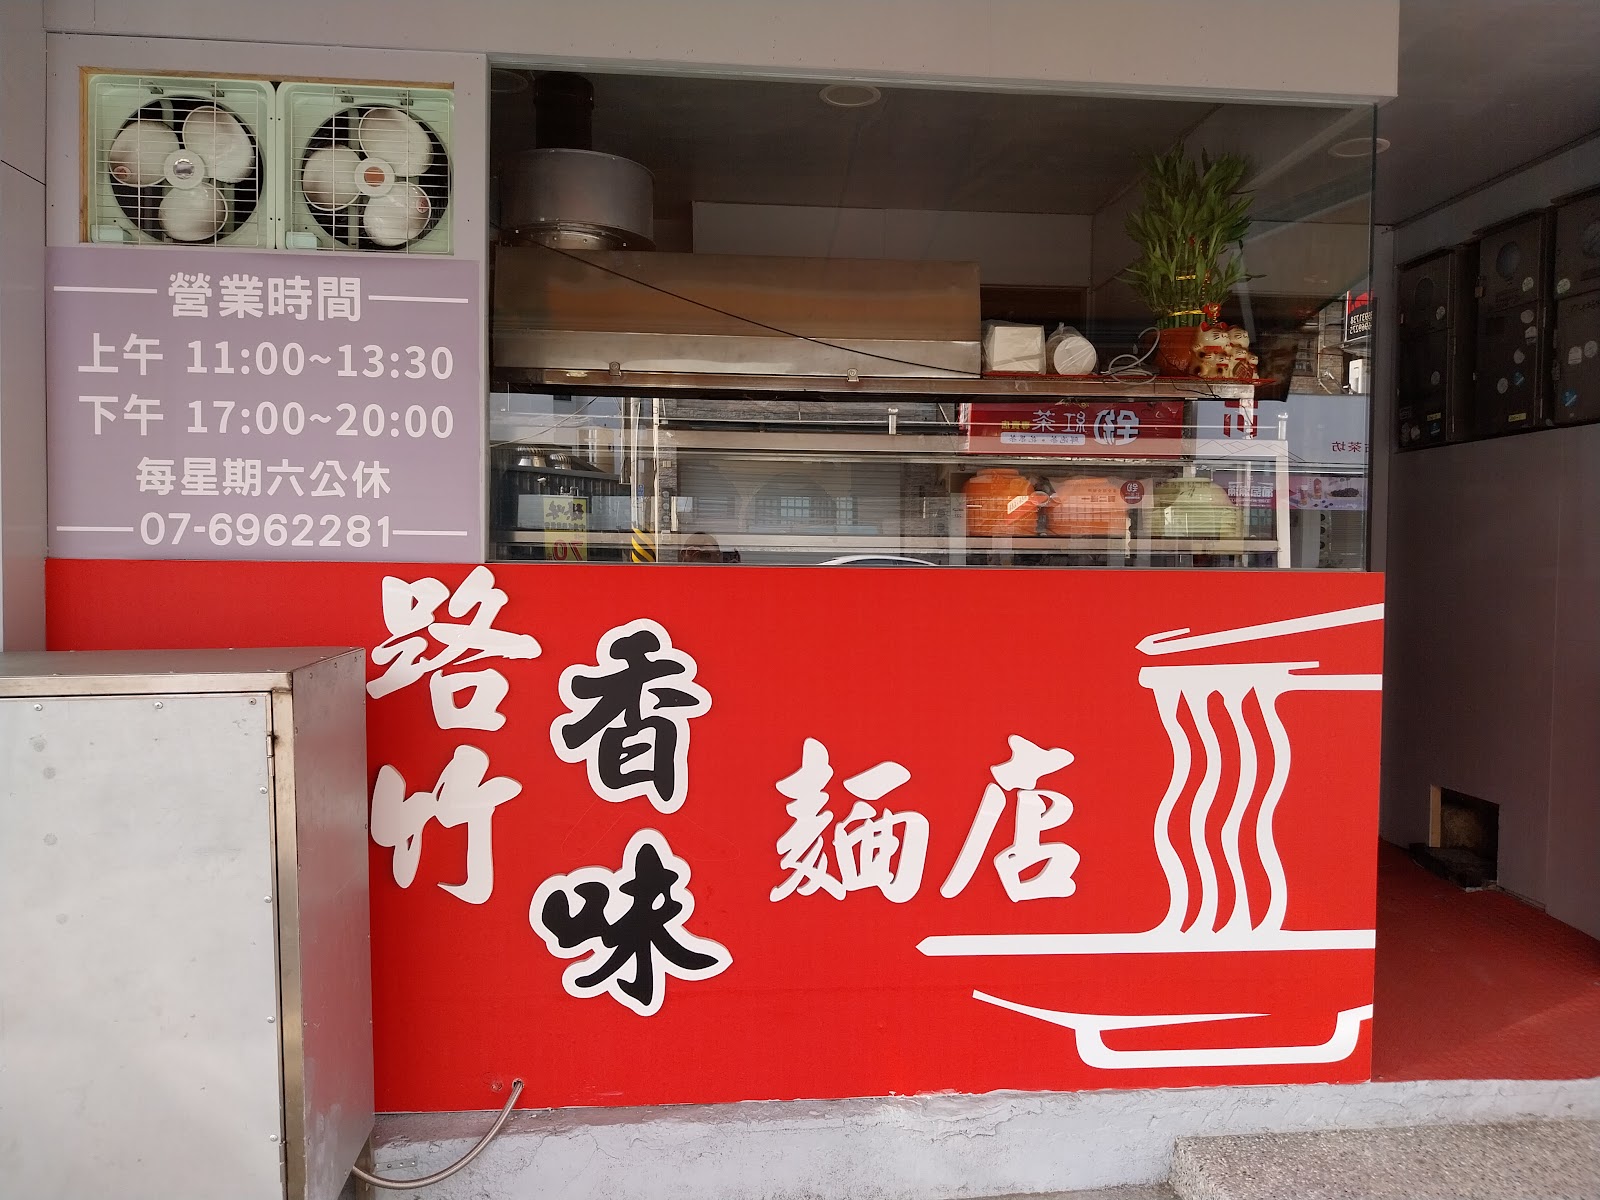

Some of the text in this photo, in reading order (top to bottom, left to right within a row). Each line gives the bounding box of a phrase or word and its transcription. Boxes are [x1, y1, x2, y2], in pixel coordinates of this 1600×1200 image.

[168, 272, 362, 322] 營業時間
[78, 332, 455, 380] 上午 11:00~13:30
[79, 394, 455, 439] 下午 17:00~20:00
[136, 456, 392, 499] 每星期六公休
[139, 512, 390, 548] 07-6962281
[366, 565, 543, 905] 路竹
[535, 624, 725, 1011] 香味
[769, 734, 1081, 904] 麵店
